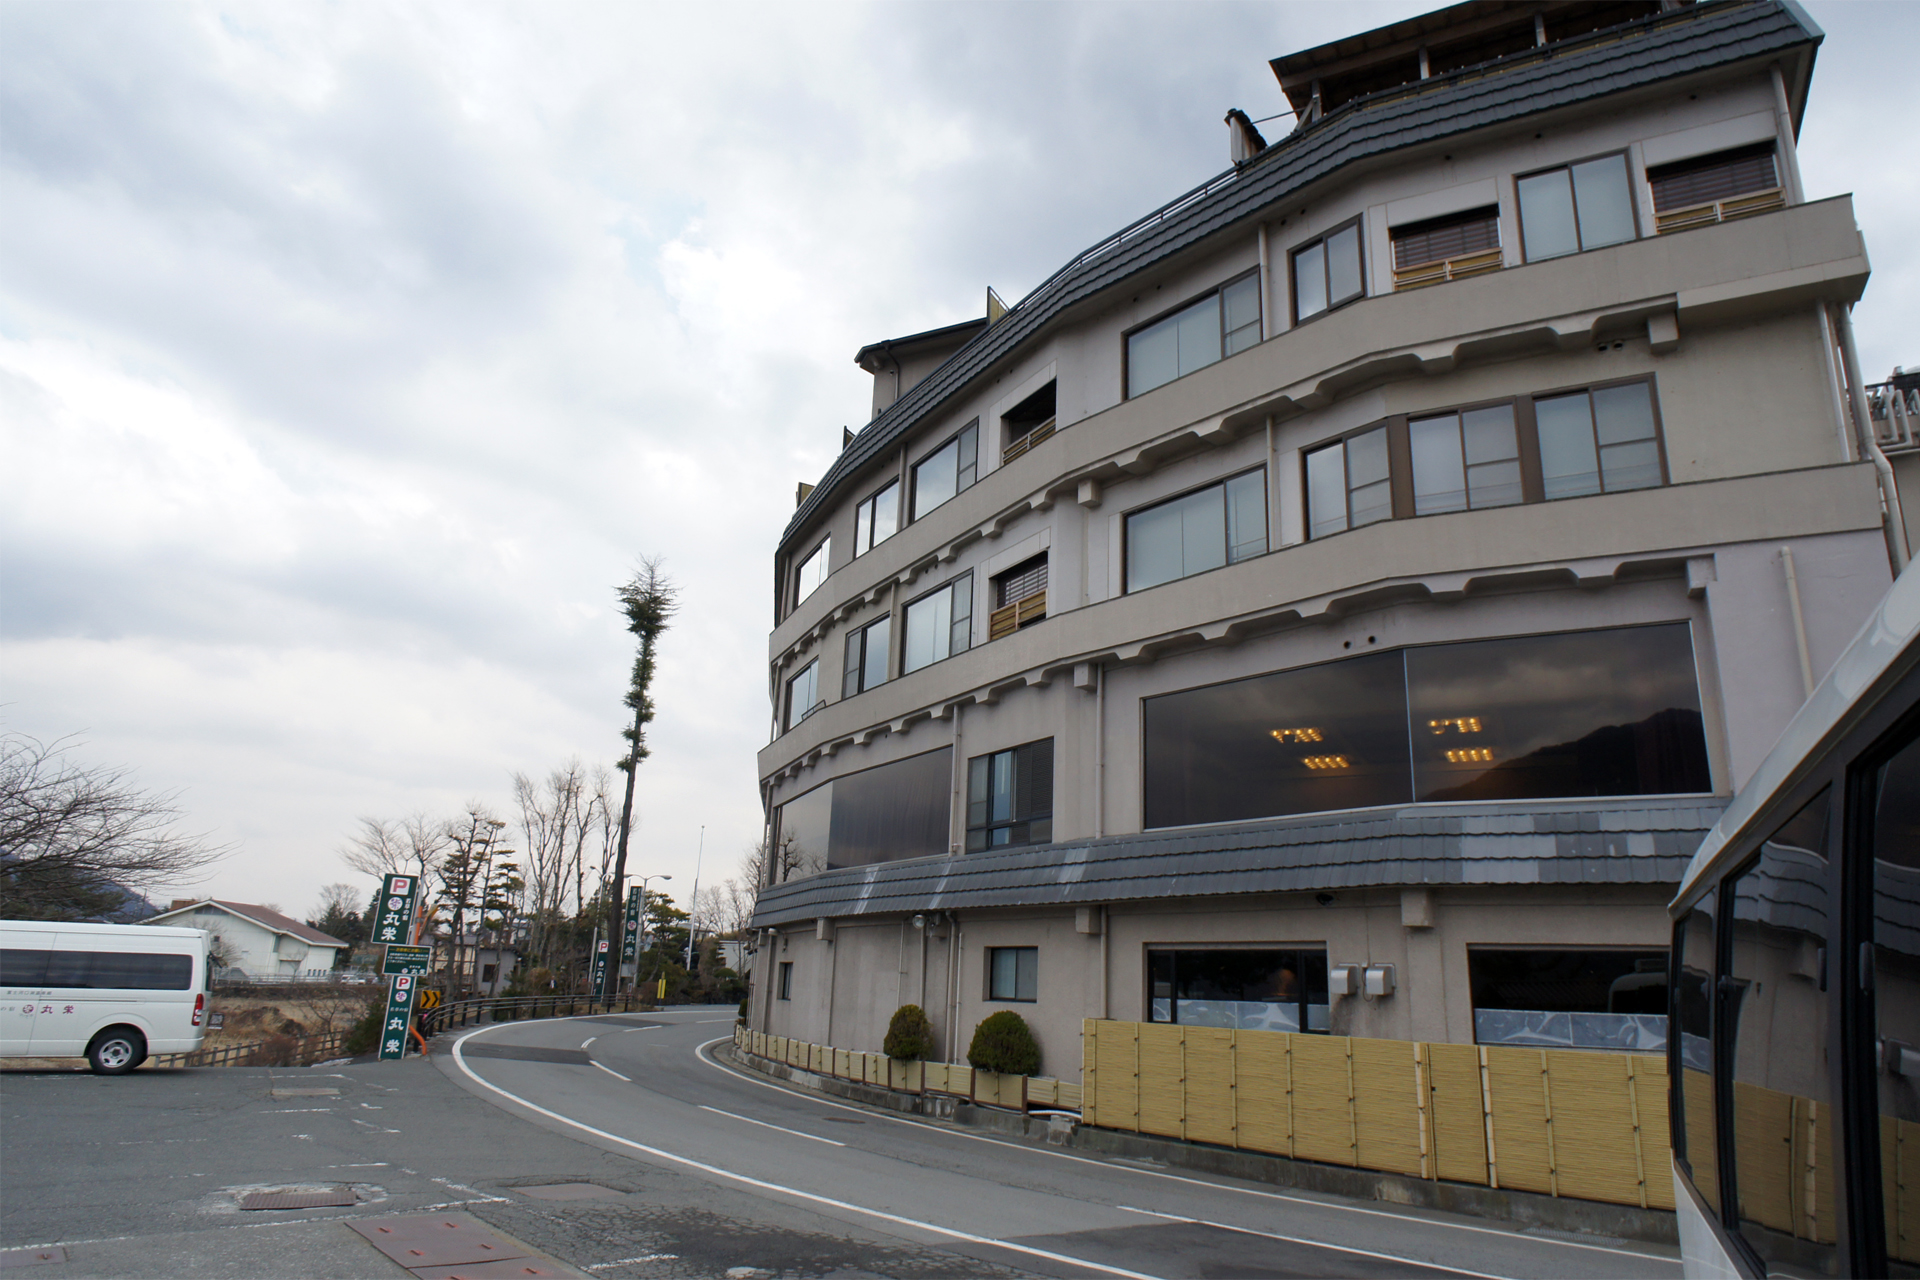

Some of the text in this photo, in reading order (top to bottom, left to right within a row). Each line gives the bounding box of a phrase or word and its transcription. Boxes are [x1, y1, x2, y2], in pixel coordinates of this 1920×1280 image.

[393, 879, 408, 893] P
[381, 911, 401, 941] 丸栄
[398, 978, 409, 988] P
[41, 1005, 74, 1014] 丸栄
[385, 1016, 404, 1053] 丸栄
